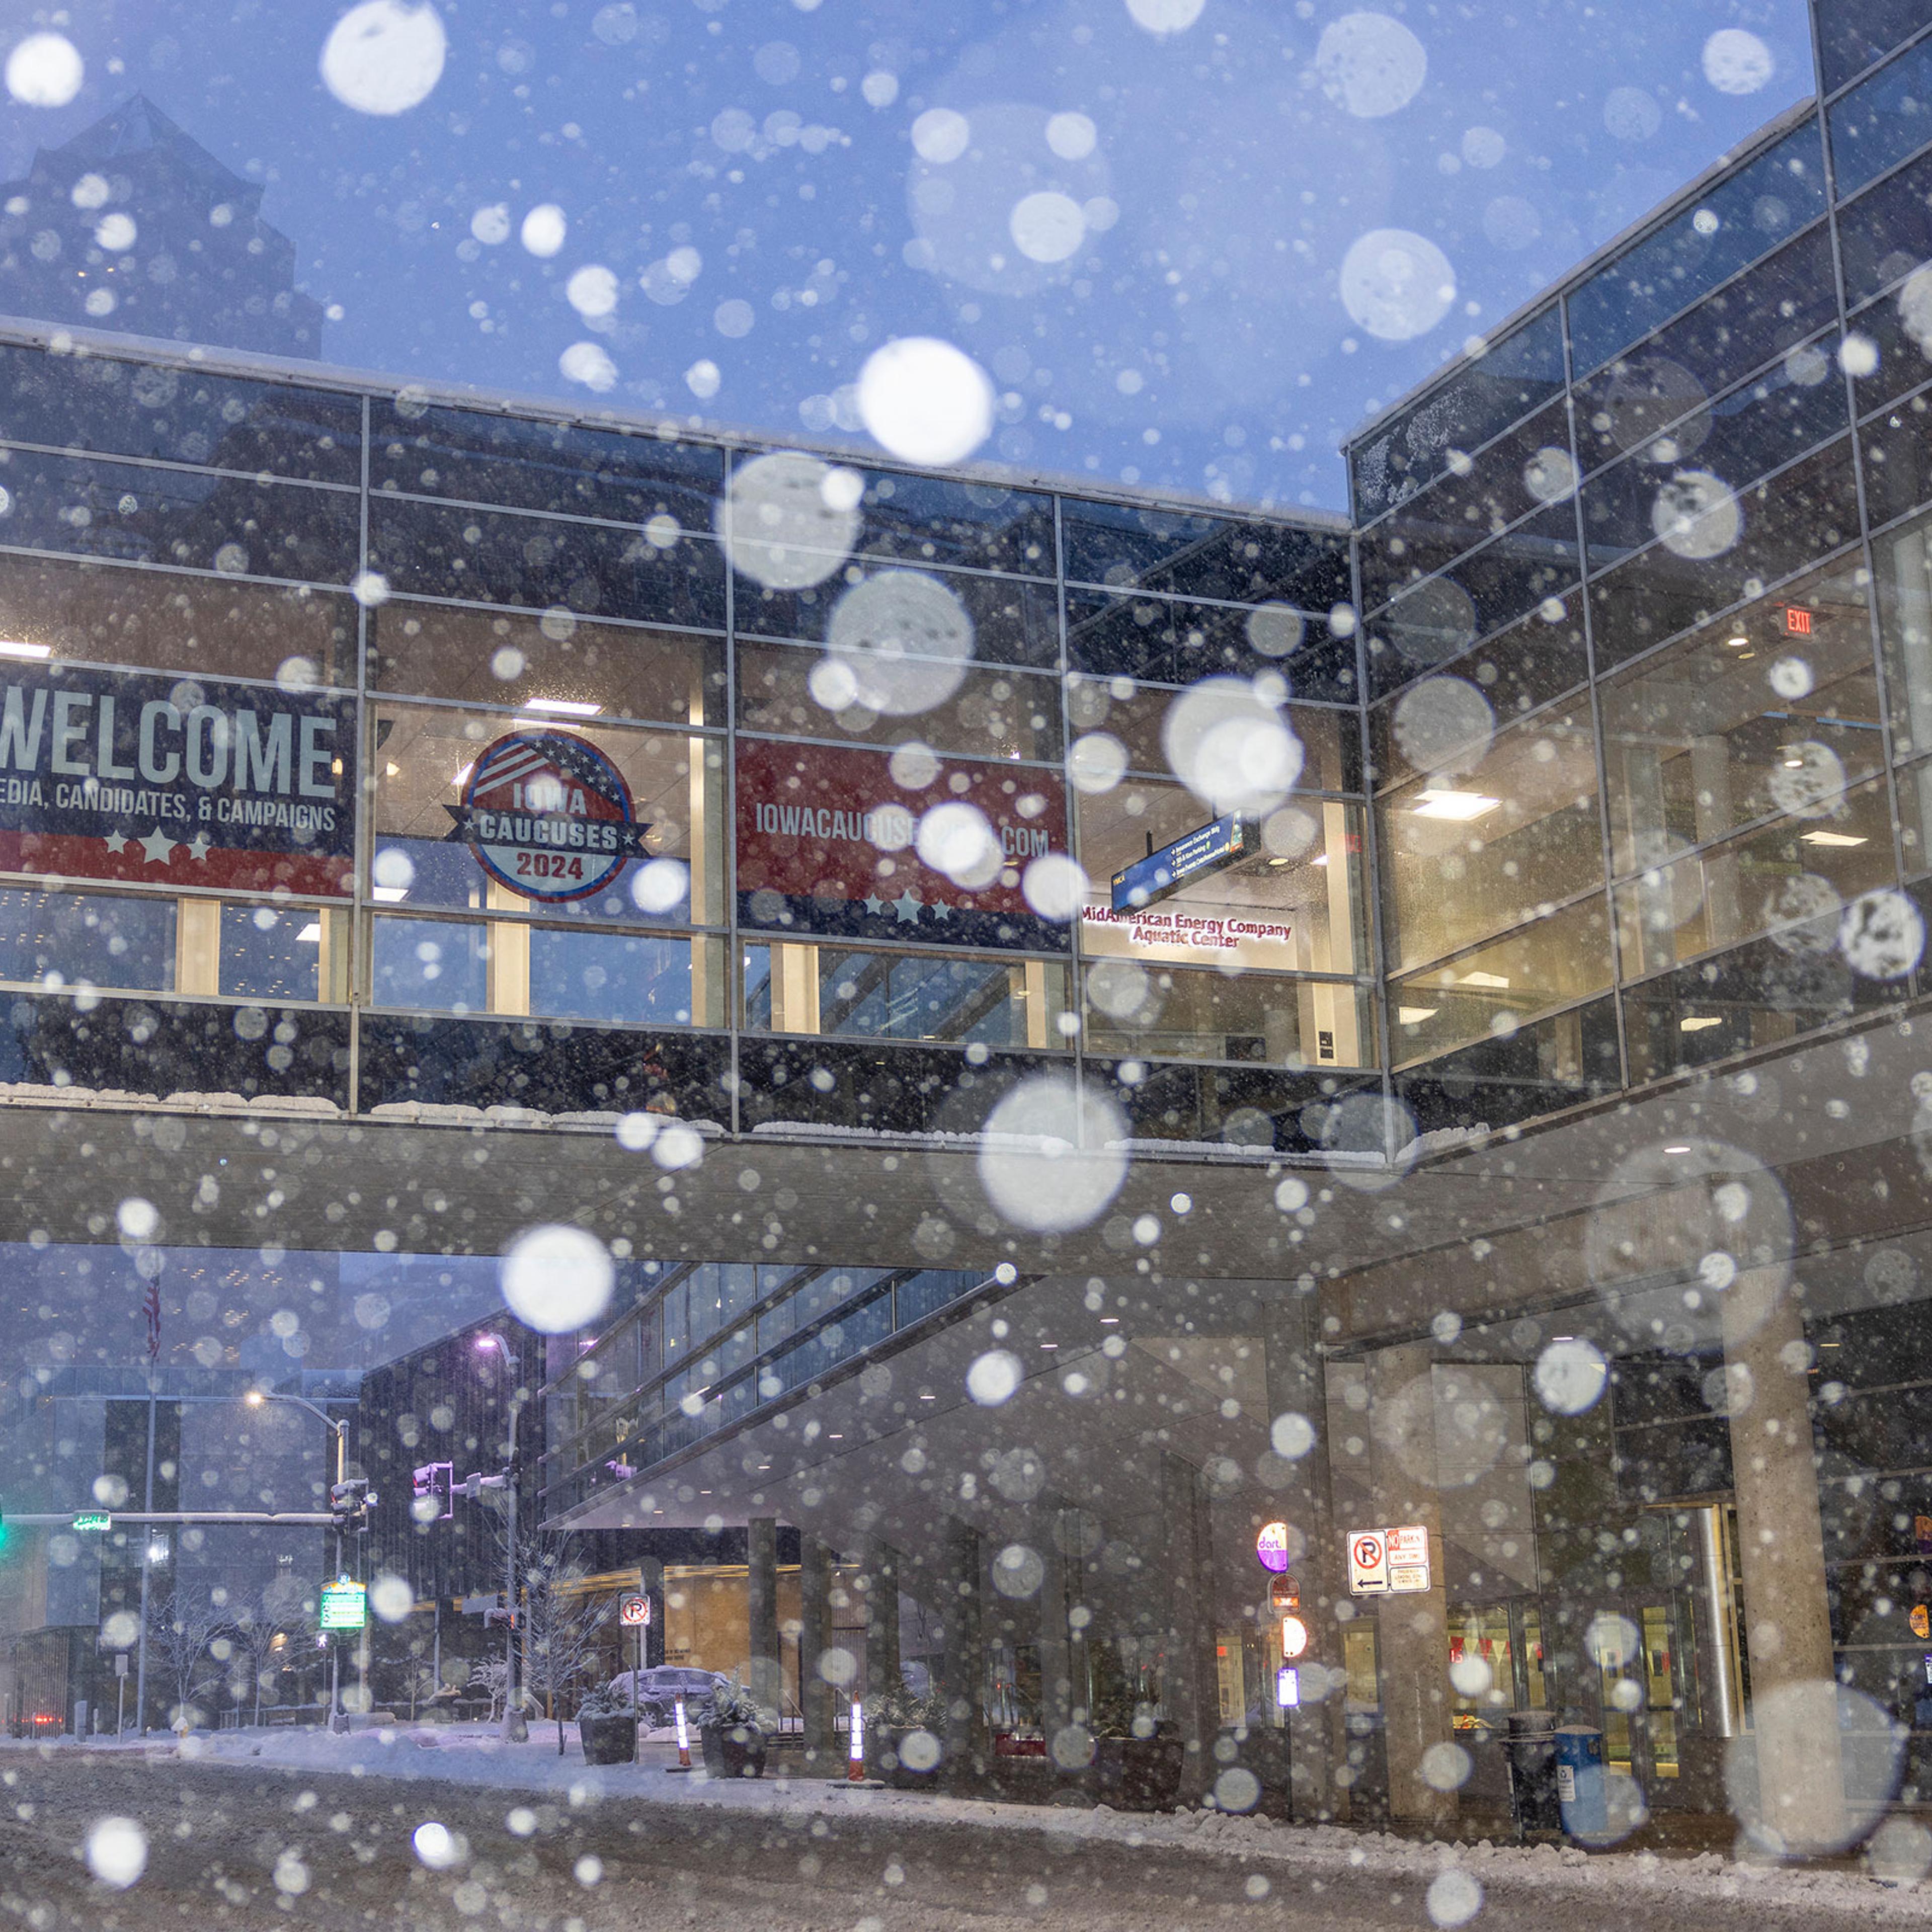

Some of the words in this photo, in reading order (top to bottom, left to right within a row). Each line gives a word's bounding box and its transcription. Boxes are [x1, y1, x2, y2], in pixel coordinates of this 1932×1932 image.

[1787, 608, 1811, 634] EXIT
[0, 685, 336, 798] WELCOME
[56, 783, 191, 822] CANDIDATES,
[198, 796, 212, 821] &
[217, 797, 336, 832] CAMPAIGNS
[479, 815, 618, 850] CAUCUSES
[516, 852, 584, 880] 2024
[1133, 926, 1188, 945] Aquatic
[1191, 931, 1240, 947] Center
[1175, 914, 1224, 934] Energy
[1228, 918, 1292, 940] Company
